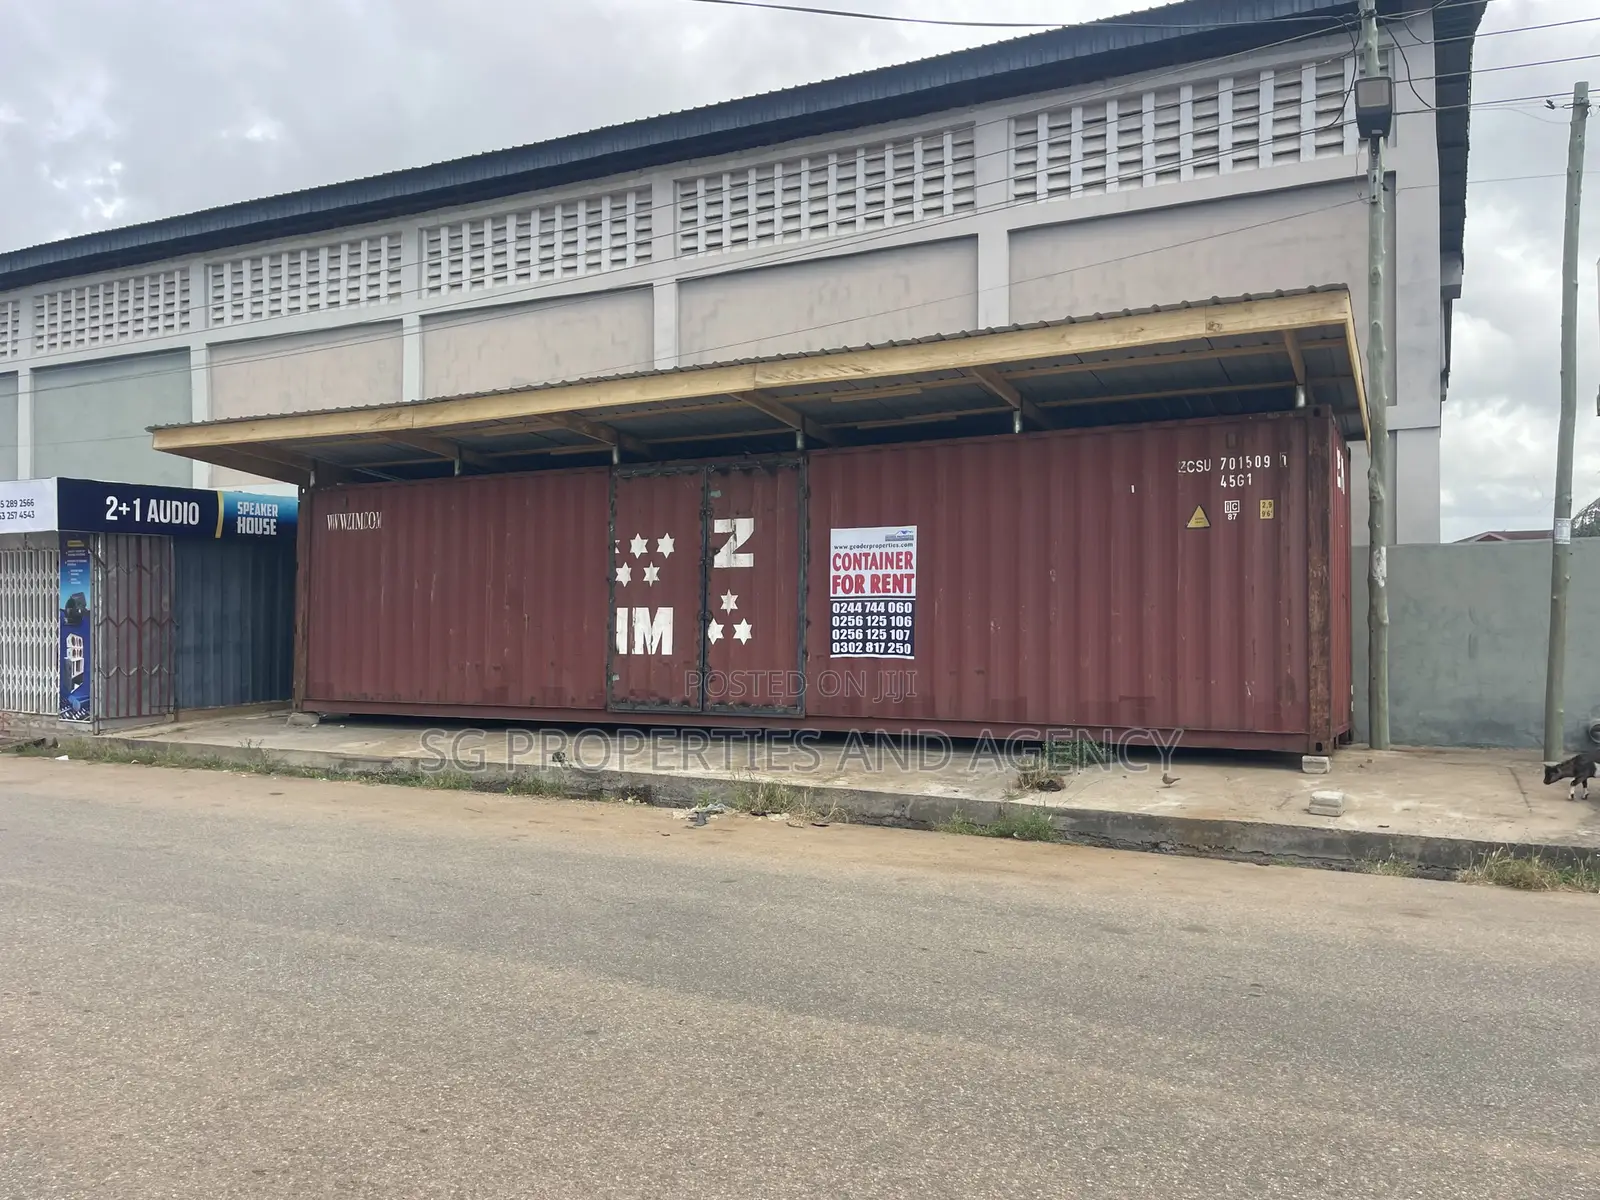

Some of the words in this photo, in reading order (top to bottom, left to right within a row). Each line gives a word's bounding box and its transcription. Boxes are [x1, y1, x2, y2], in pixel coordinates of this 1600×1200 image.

[1220, 454, 1271, 471] 701509
[1220, 472, 1252, 488] 45G1
[5, 499, 18, 508] 289
[19, 498, 35, 508] 2566
[237, 501, 279, 518] SPEAKER
[6, 511, 18, 520] 257
[19, 510, 35, 519] 4543
[147, 498, 200, 526] AUDIO
[1227, 513, 1238, 521] 87
[237, 516, 277, 536] HOUSE
[713, 517, 755, 569] Z
[832, 550, 914, 572] CONTAINER
[831, 573, 866, 595] FOR
[870, 573, 915, 594] RENT
[832, 602, 863, 614] 0244
[864, 601, 886, 613] 744
[888, 601, 912, 614] 060
[832, 615, 863, 627] 0256
[865, 615, 887, 627] 125
[889, 615, 912, 627] 106
[615, 606, 674, 656] IM
[832, 628, 863, 640] 0256
[865, 628, 887, 640] 125
[889, 629, 910, 641] 107
[832, 642, 863, 653] 0302
[865, 641, 886, 653] 817
[887, 642, 911, 655] 250
